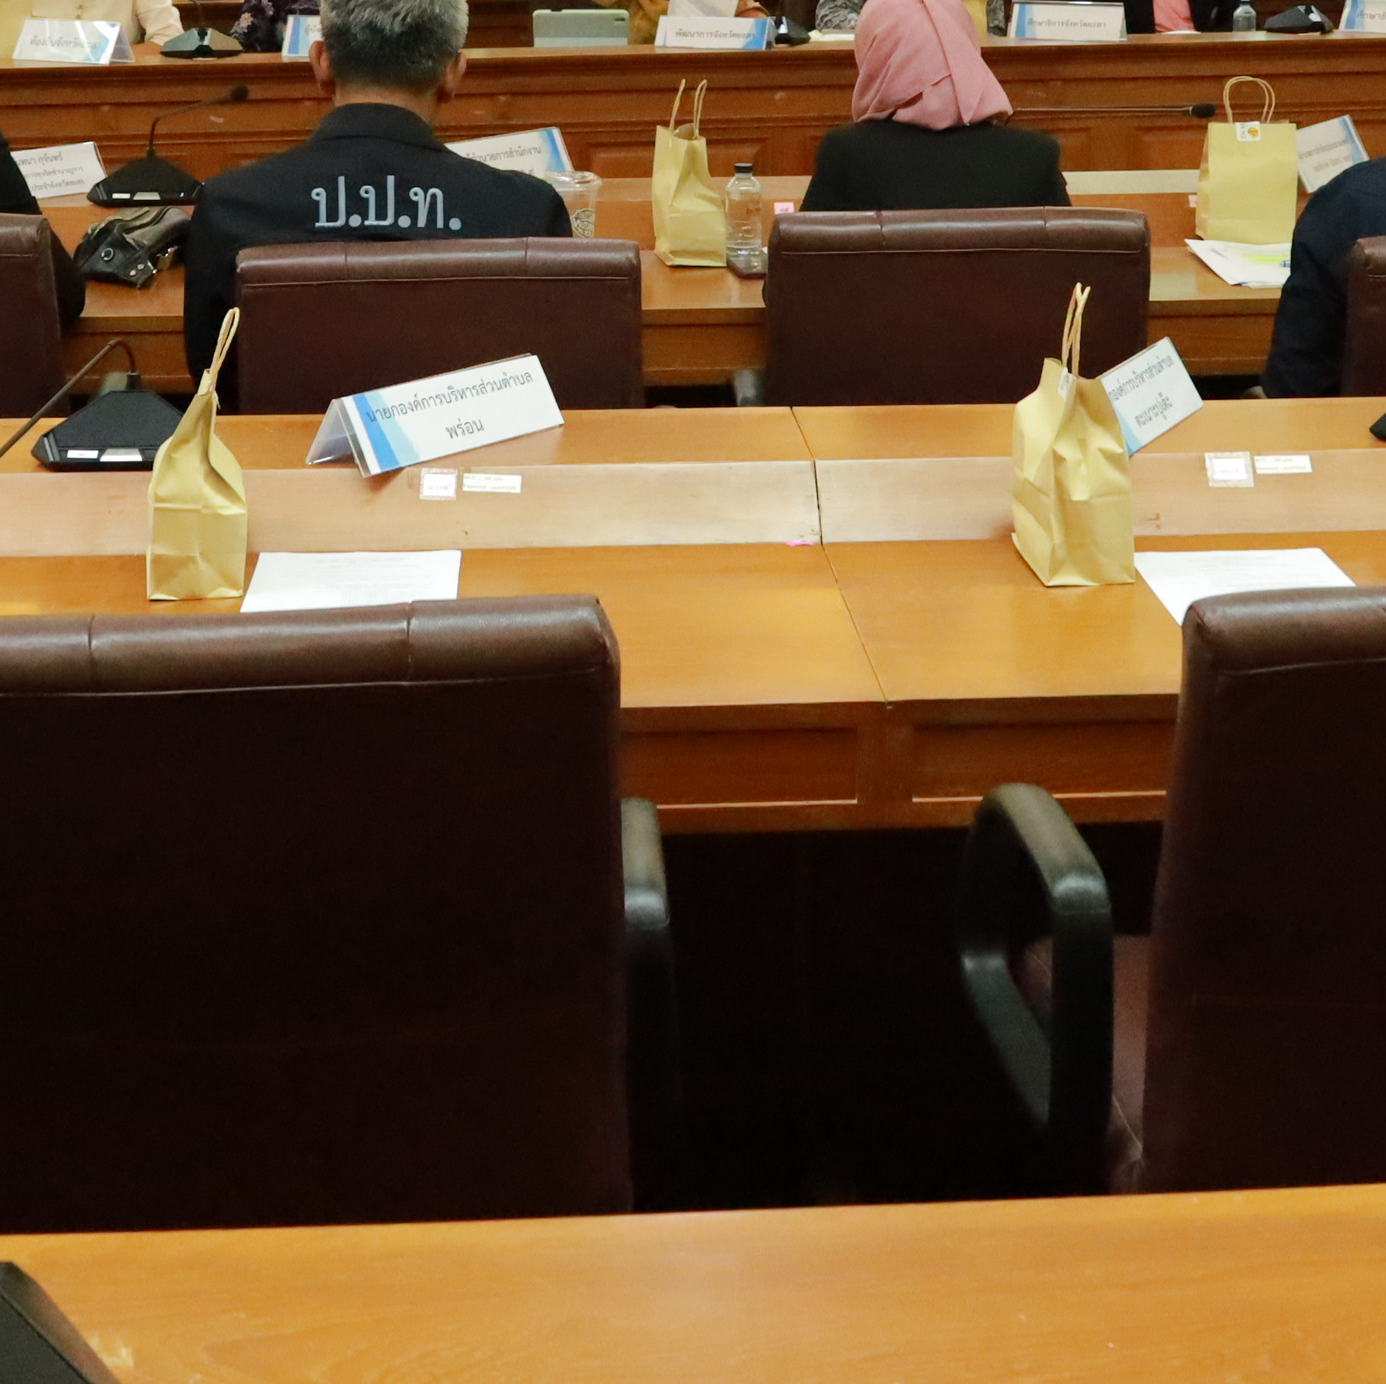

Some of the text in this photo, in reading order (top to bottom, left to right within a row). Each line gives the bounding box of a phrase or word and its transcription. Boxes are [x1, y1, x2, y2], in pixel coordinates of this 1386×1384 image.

[311, 175, 462, 230] ป.ป.ท.
[365, 370, 534, 424] นายกองค์การบริหารส่วนตำบล
[445, 417, 485, 440] พร่อน
